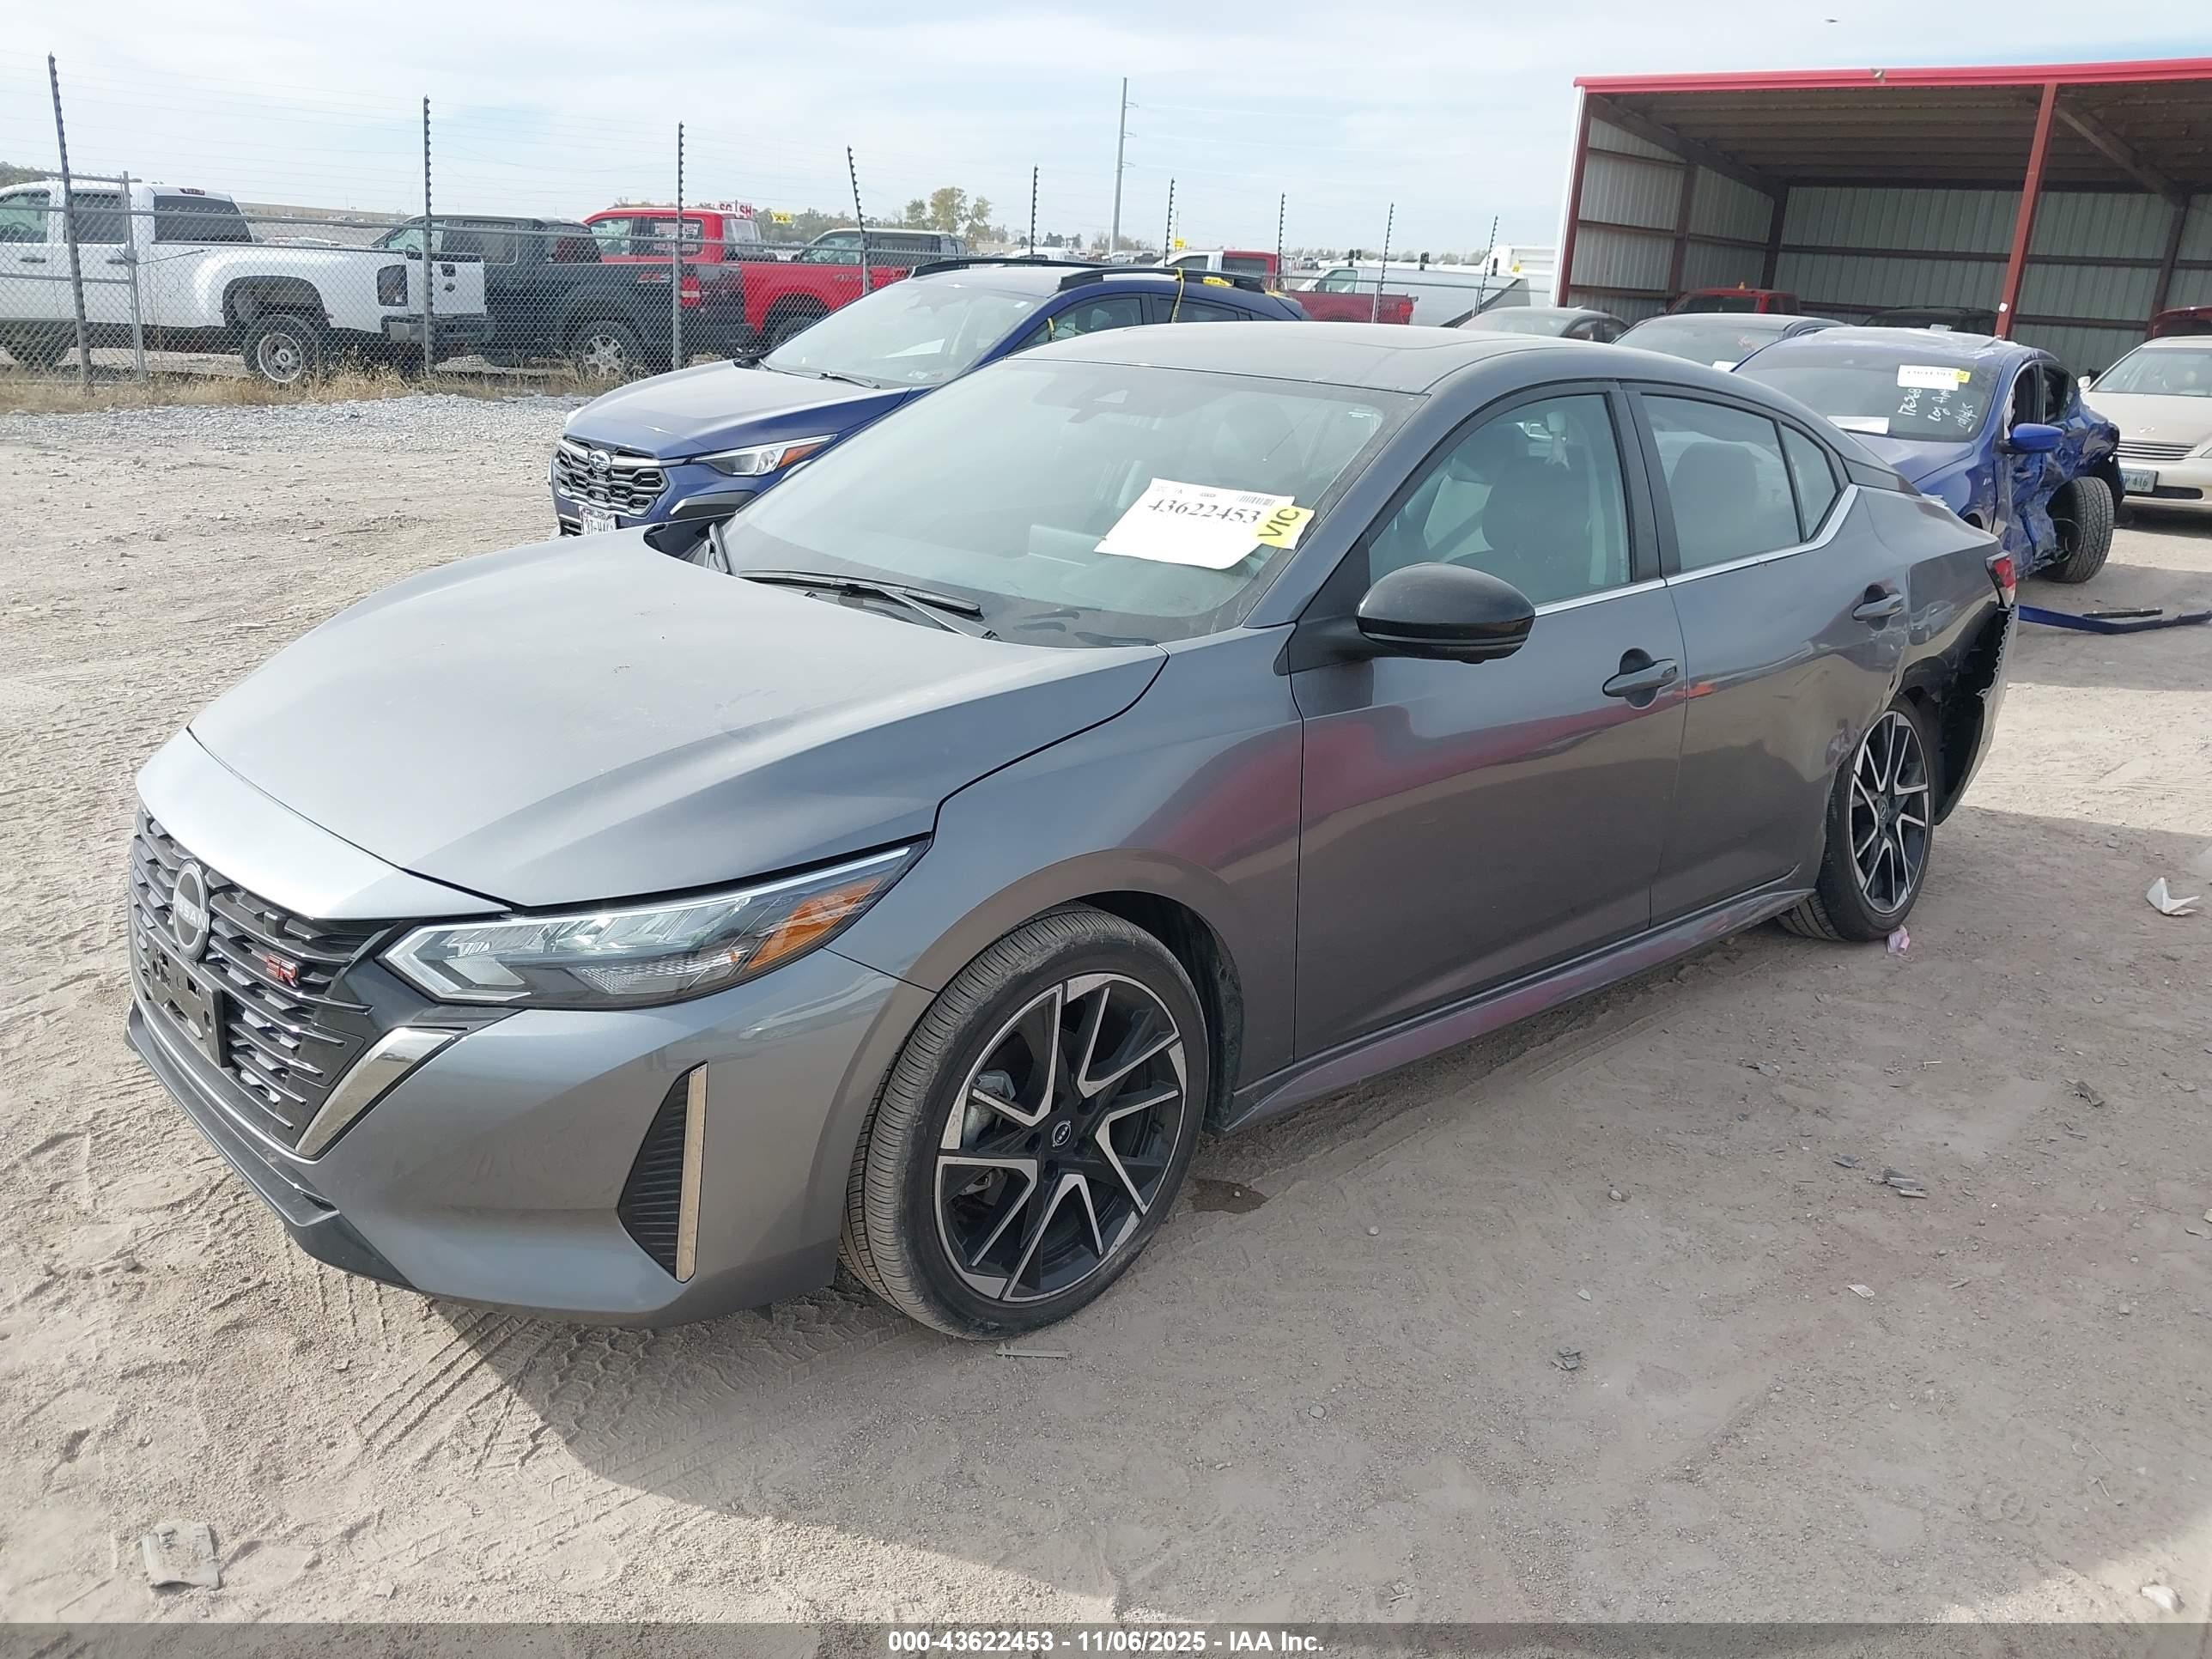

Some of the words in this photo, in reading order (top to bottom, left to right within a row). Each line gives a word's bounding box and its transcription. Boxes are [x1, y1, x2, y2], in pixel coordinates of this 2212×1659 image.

[1148, 498, 1262, 524] 43622453
[1256, 508, 1301, 538] VIC
[174, 898, 207, 928] SSAN
[266, 953, 298, 988] SR
